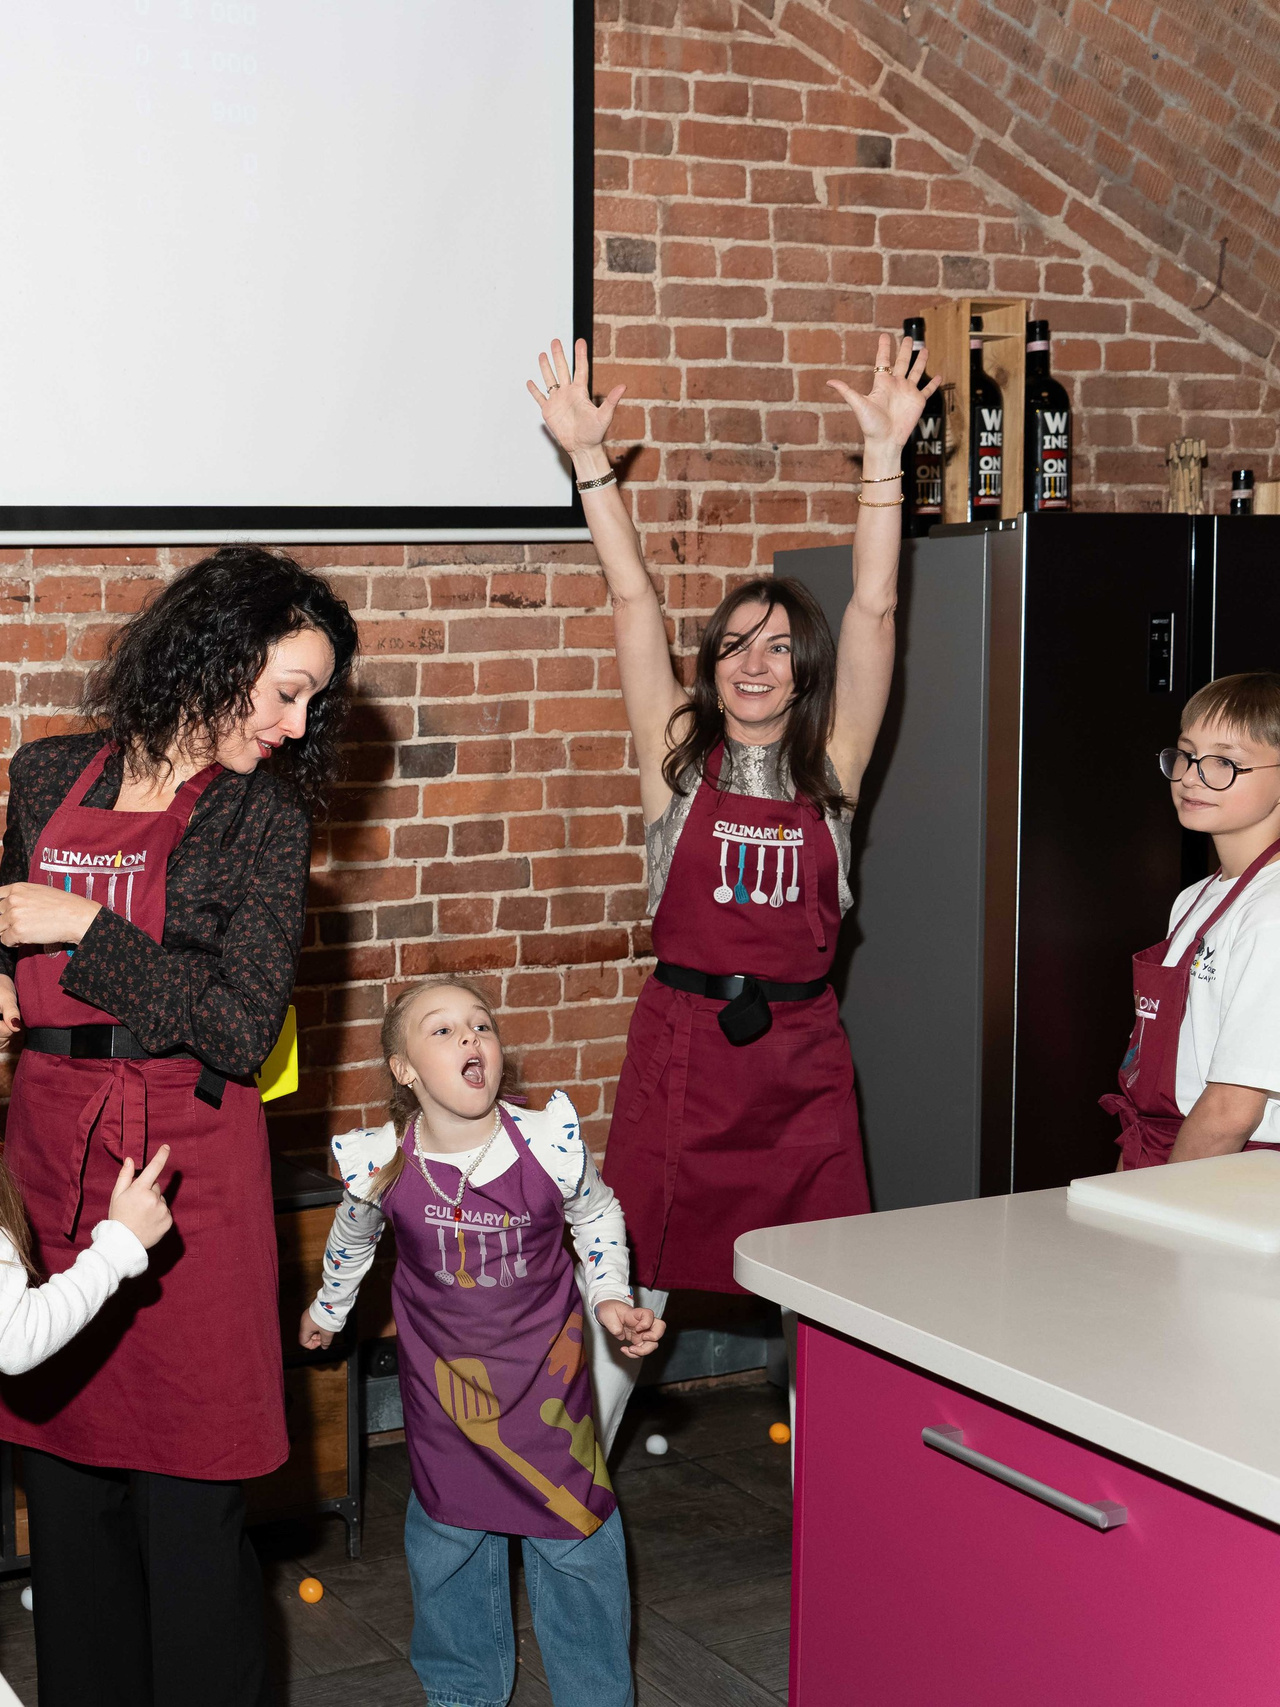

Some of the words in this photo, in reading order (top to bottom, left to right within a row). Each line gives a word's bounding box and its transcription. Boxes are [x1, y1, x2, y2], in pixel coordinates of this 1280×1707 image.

[981, 409, 1002, 431] W
[1044, 412, 1067, 434] W
[918, 418, 941, 439] W
[980, 433, 1002, 446] INE
[1043, 435, 1067, 449] INE
[917, 441, 942, 455] INE
[980, 456, 1001, 470] ON
[1043, 459, 1066, 472] ON
[917, 466, 940, 479] ON
